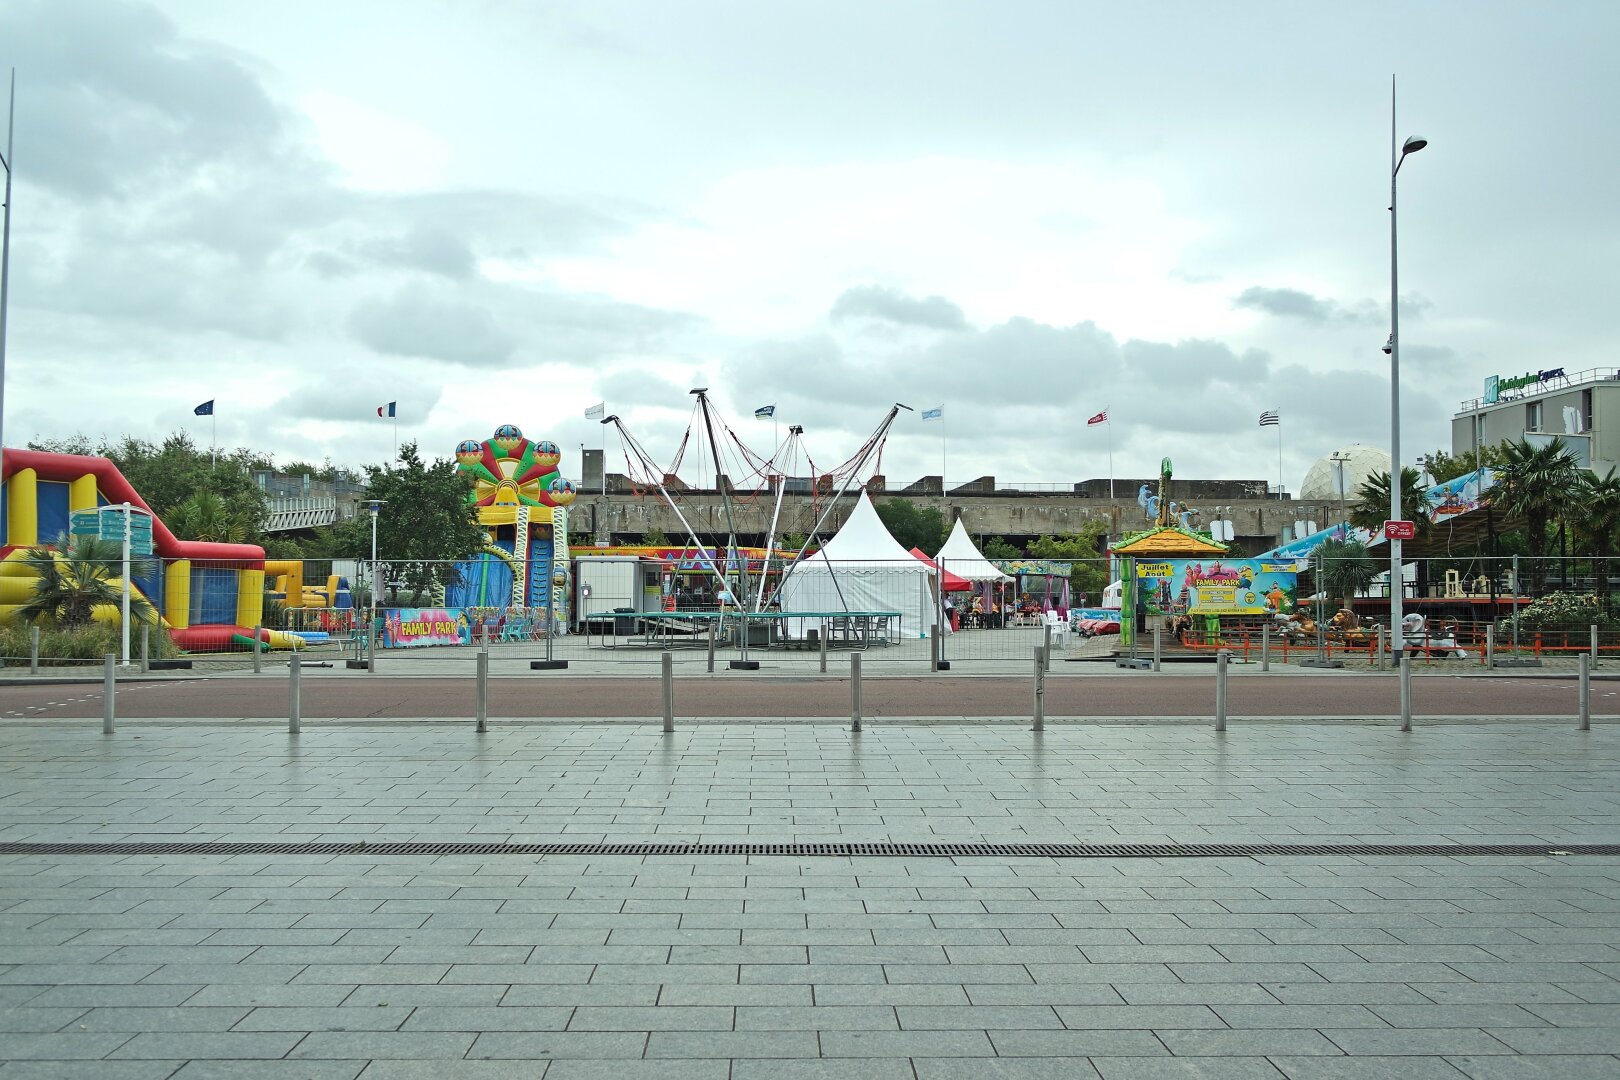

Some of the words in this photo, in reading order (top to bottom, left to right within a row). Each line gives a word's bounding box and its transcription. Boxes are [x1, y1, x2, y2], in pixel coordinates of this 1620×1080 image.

[1196, 578, 1220, 586] FAMILY
[1221, 578, 1240, 586] PARK
[401, 621, 432, 636] FAMILY
[435, 620, 457, 635] PARK
